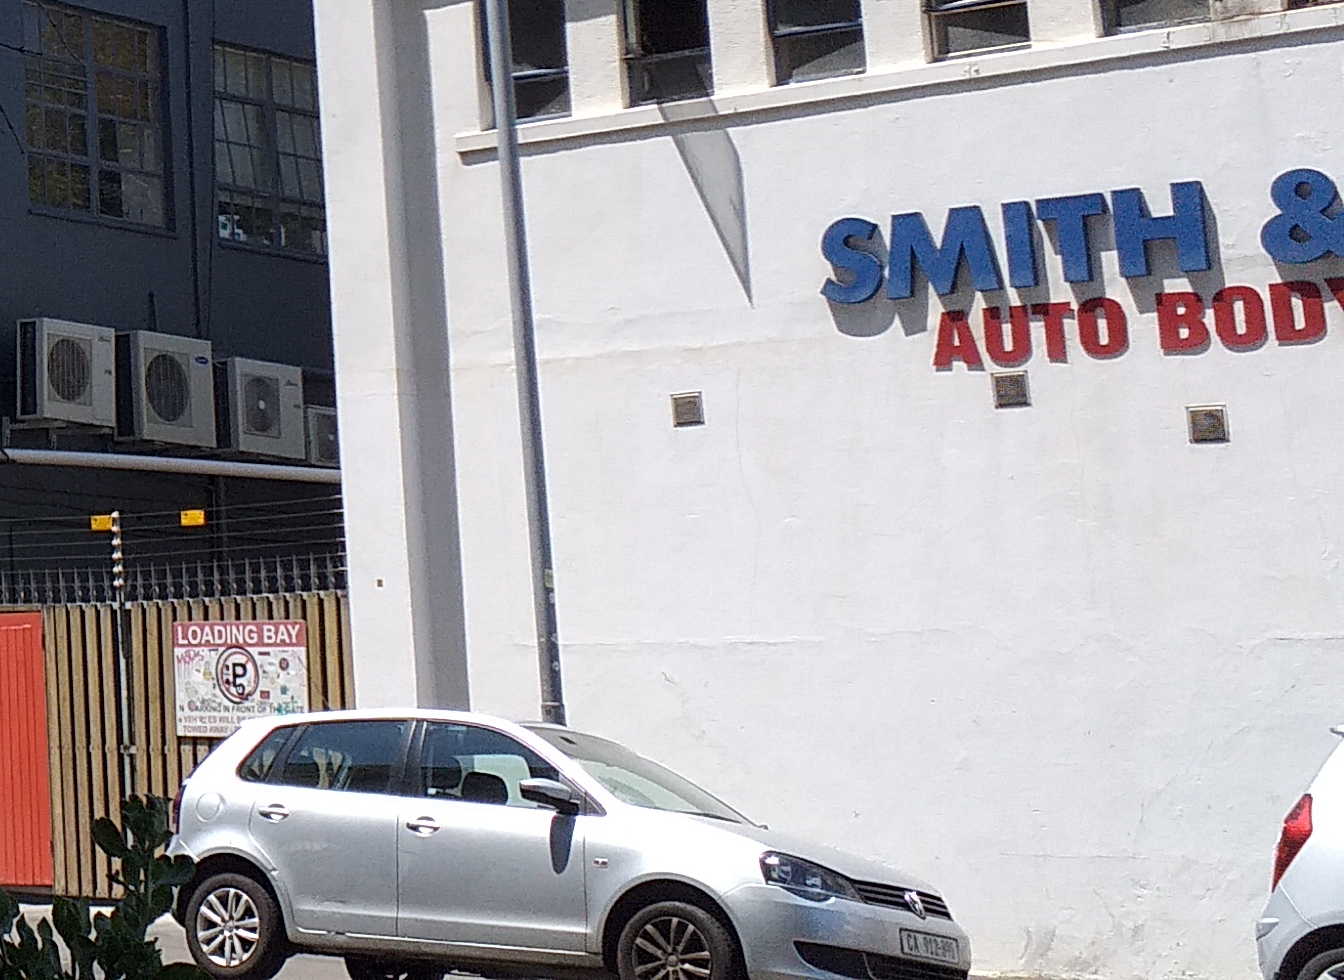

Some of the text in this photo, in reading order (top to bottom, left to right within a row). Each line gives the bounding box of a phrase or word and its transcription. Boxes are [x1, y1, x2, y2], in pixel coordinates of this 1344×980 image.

[819, 167, 1344, 305] SMITH &
[932, 278, 1344, 372] AUTO BOD
[177, 624, 300, 645] LOADING BAY
[189, 704, 221, 713] ARKING
[232, 704, 255, 713] FRONT
[906, 932, 920, 955] CA
